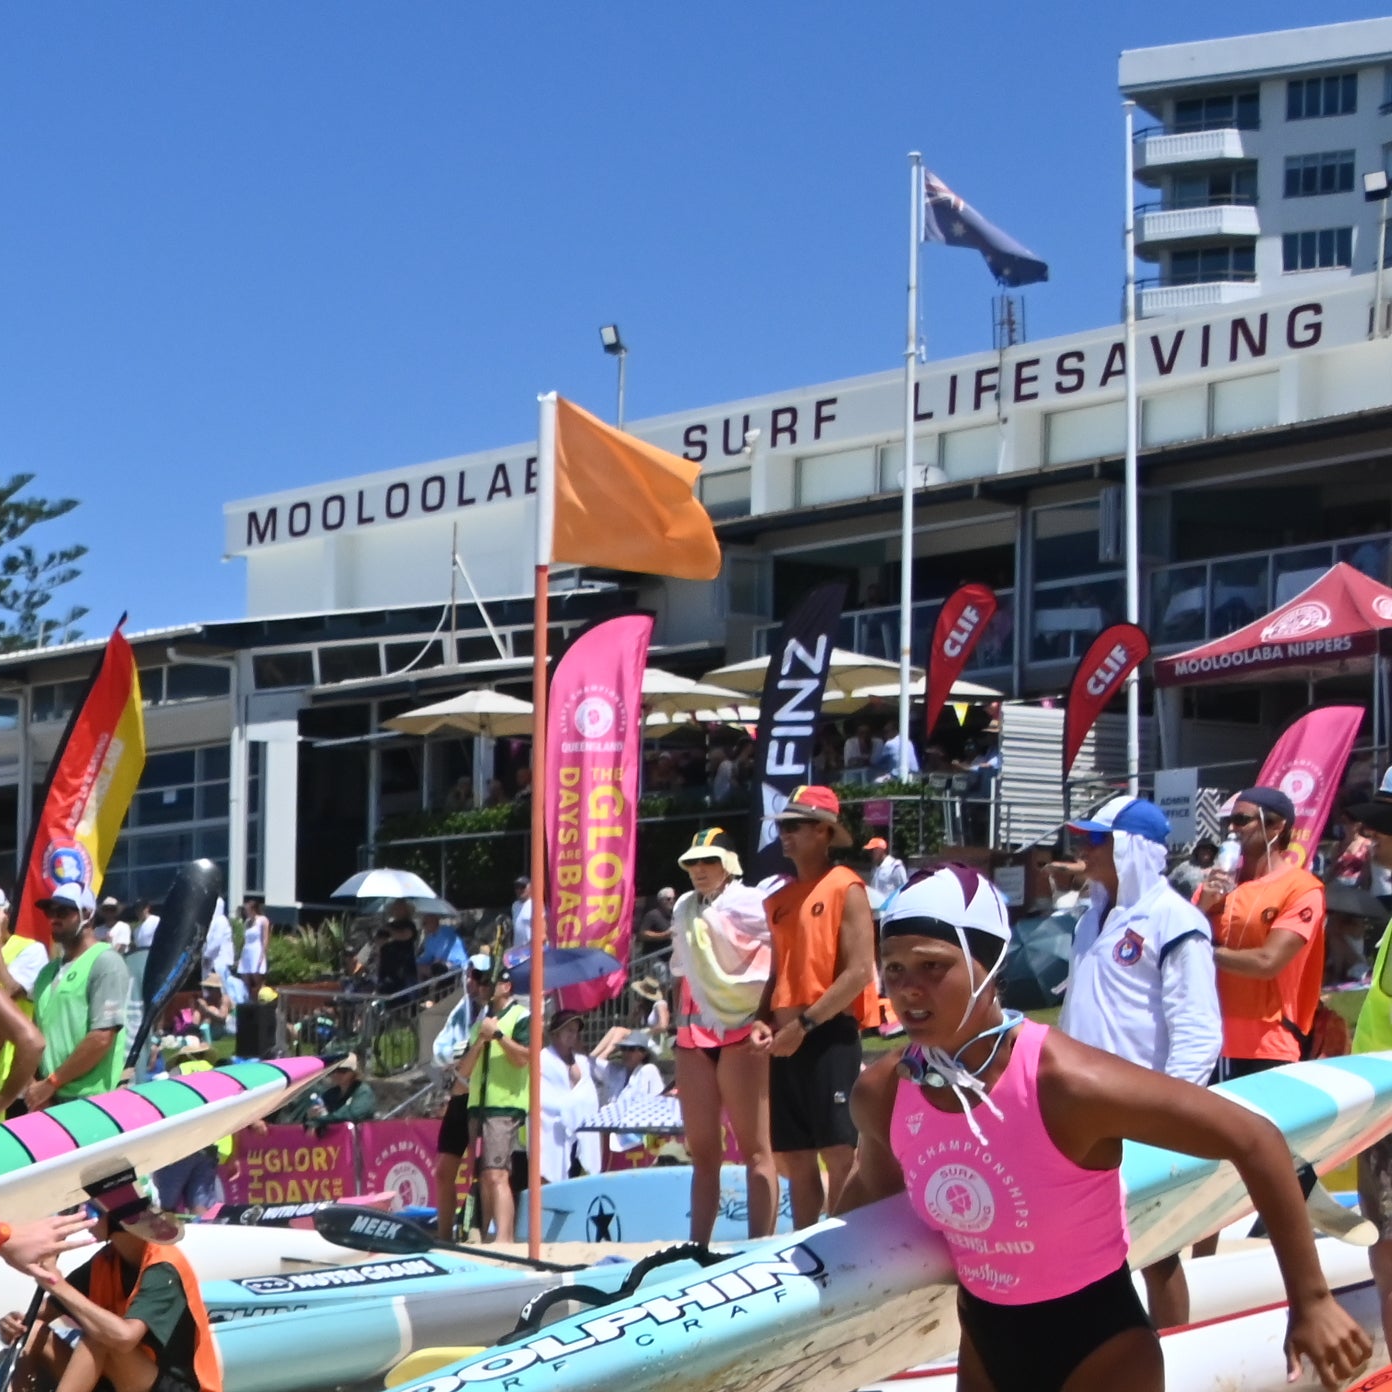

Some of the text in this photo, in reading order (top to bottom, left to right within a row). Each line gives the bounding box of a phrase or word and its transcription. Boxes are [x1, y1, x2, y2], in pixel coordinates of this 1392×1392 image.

[246, 456, 540, 547] MOOLOOLAB
[682, 397, 839, 464] SURF
[913, 302, 1324, 422] LIFESAVING
[943, 604, 981, 659] CLIF
[1086, 643, 1129, 697] CLIF
[1174, 636, 1352, 676] MOOLOOLABA NIPPERS
[766, 633, 827, 777] FINZ
[561, 741, 625, 754] QUEENSLAND
[591, 767, 624, 783] THE
[557, 766, 581, 845] DAYS
[247, 1149, 264, 1205] THE
[265, 1146, 342, 1173] GLORY
[939, 1166, 979, 1181] SURF
[266, 1177, 331, 1205] DAYS
[917, 1138, 1029, 1229] CHAMPIONSHIPS
[349, 1214, 405, 1241] MEEK
[360, 1258, 439, 1282] GRAIN
[635, 1272, 832, 1347] CRAFT
